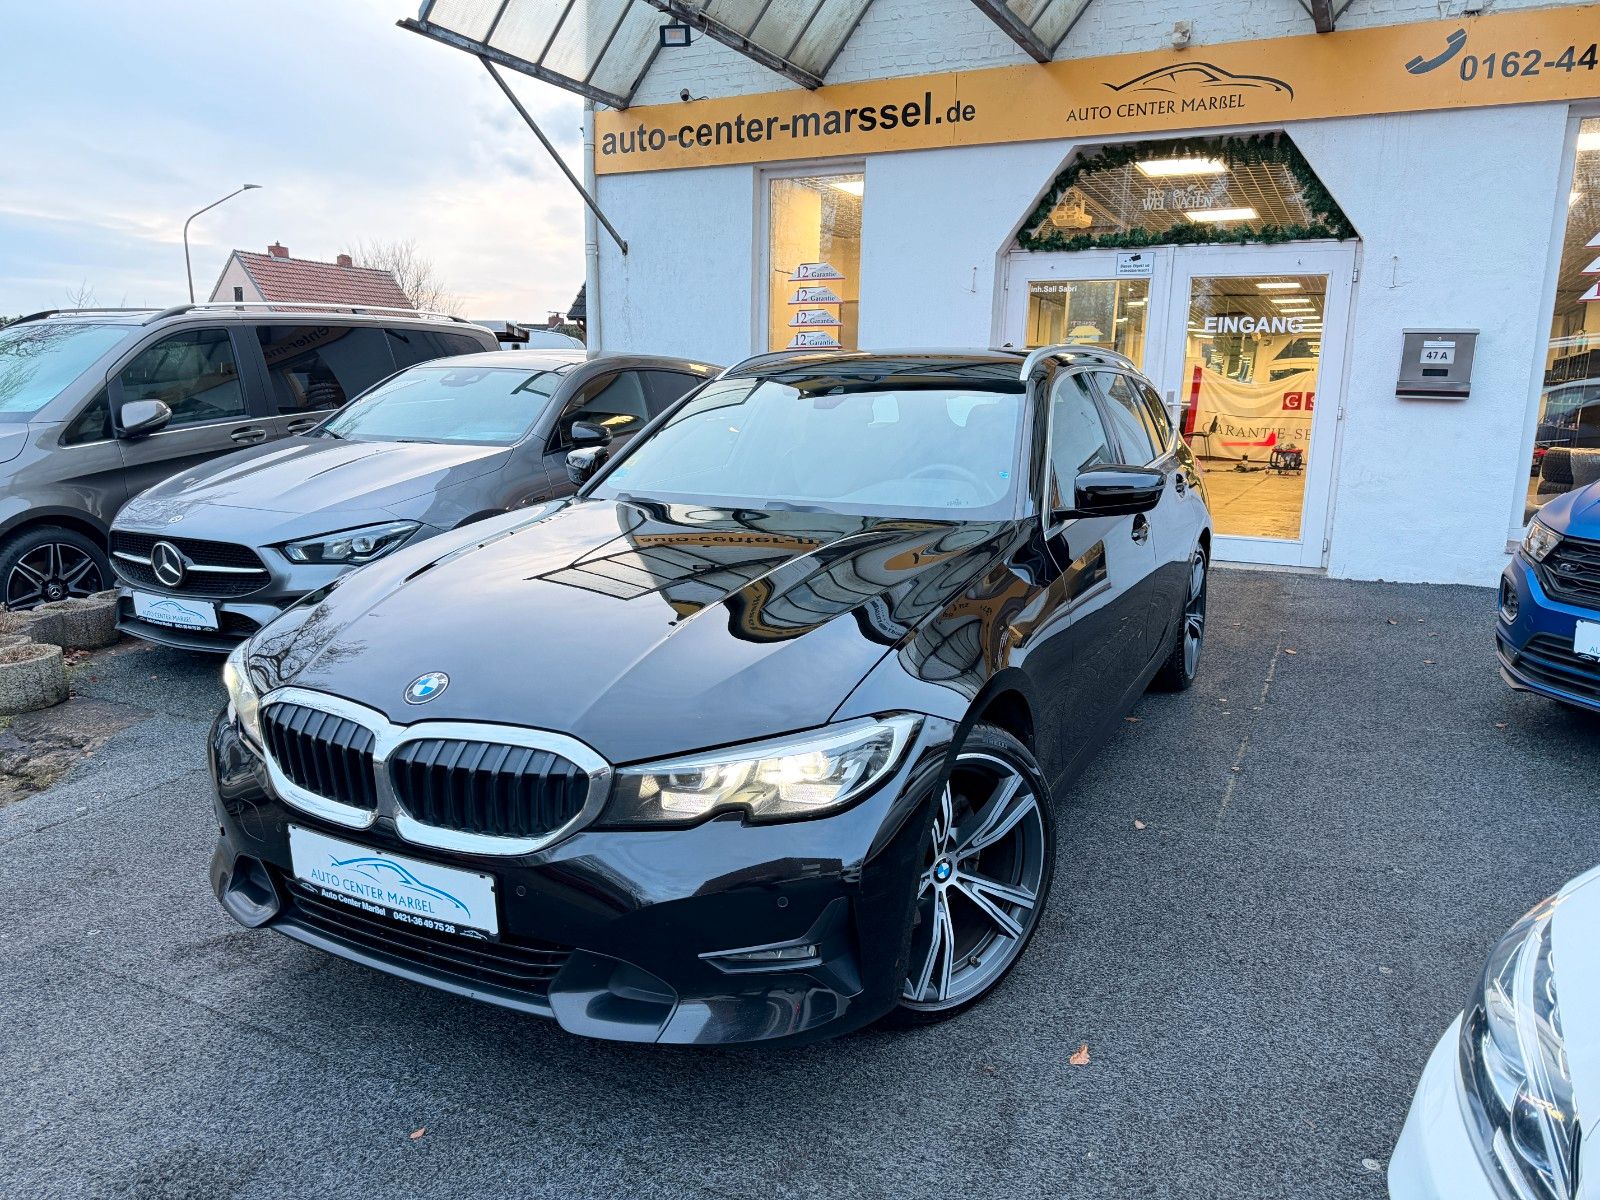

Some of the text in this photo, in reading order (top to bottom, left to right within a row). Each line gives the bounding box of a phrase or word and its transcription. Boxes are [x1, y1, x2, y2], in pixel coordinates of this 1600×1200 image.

[1460, 43, 1599, 82] 0162-44
[1066, 105, 1112, 122] AUTO
[1116, 100, 1176, 118] CENTER
[602, 91, 976, 156] auto-center-marssel.de
[797, 266, 809, 278] 12
[796, 289, 808, 302] 12
[796, 312, 808, 324] 12
[1204, 316, 1304, 334] EINGANG
[795, 334, 807, 346] 12
[1426, 351, 1448, 360] 47 A
[311, 868, 340, 887] AUTO
[342, 879, 385, 901] CENTER
[321, 889, 338, 900] Auto
[338, 894, 361, 908] Center
[393, 911, 423, 926] 0421-36
[423, 919, 434, 929] 49
[434, 921, 445, 931] 75
[445, 925, 456, 934] 26
